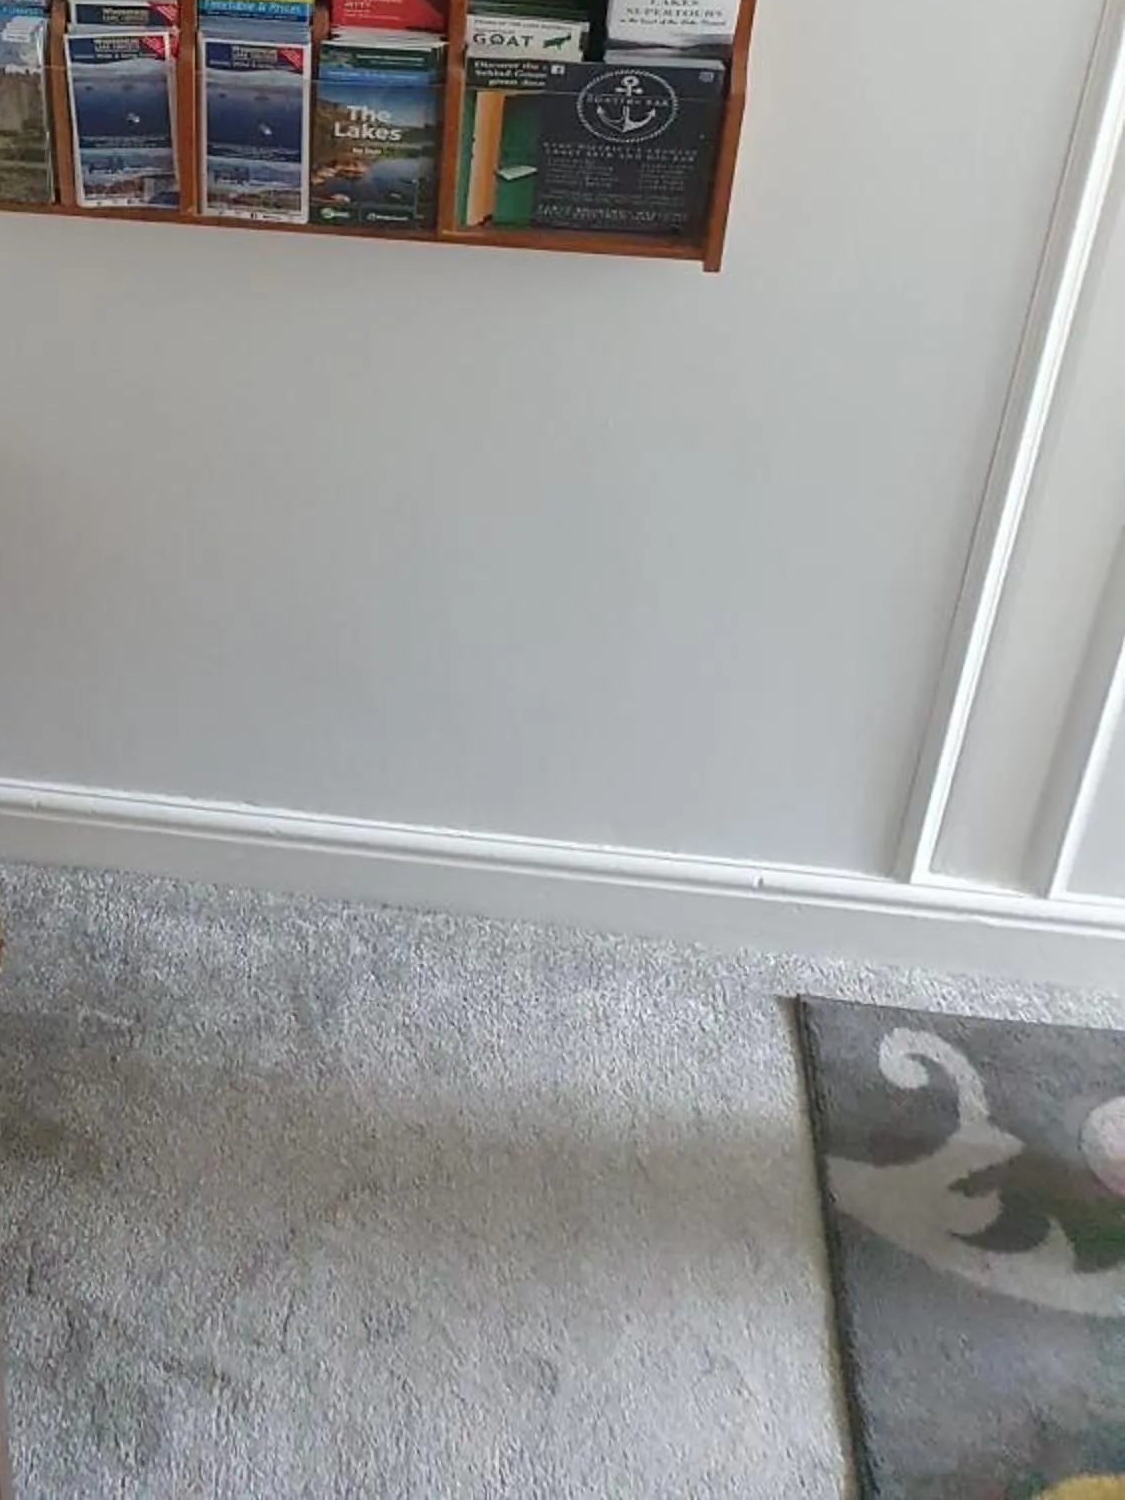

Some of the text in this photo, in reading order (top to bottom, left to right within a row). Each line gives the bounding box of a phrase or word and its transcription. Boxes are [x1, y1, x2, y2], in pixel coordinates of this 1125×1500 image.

[473, 33, 534, 48] GOAT
[347, 105, 391, 123] The
[335, 122, 402, 141] Lakes
